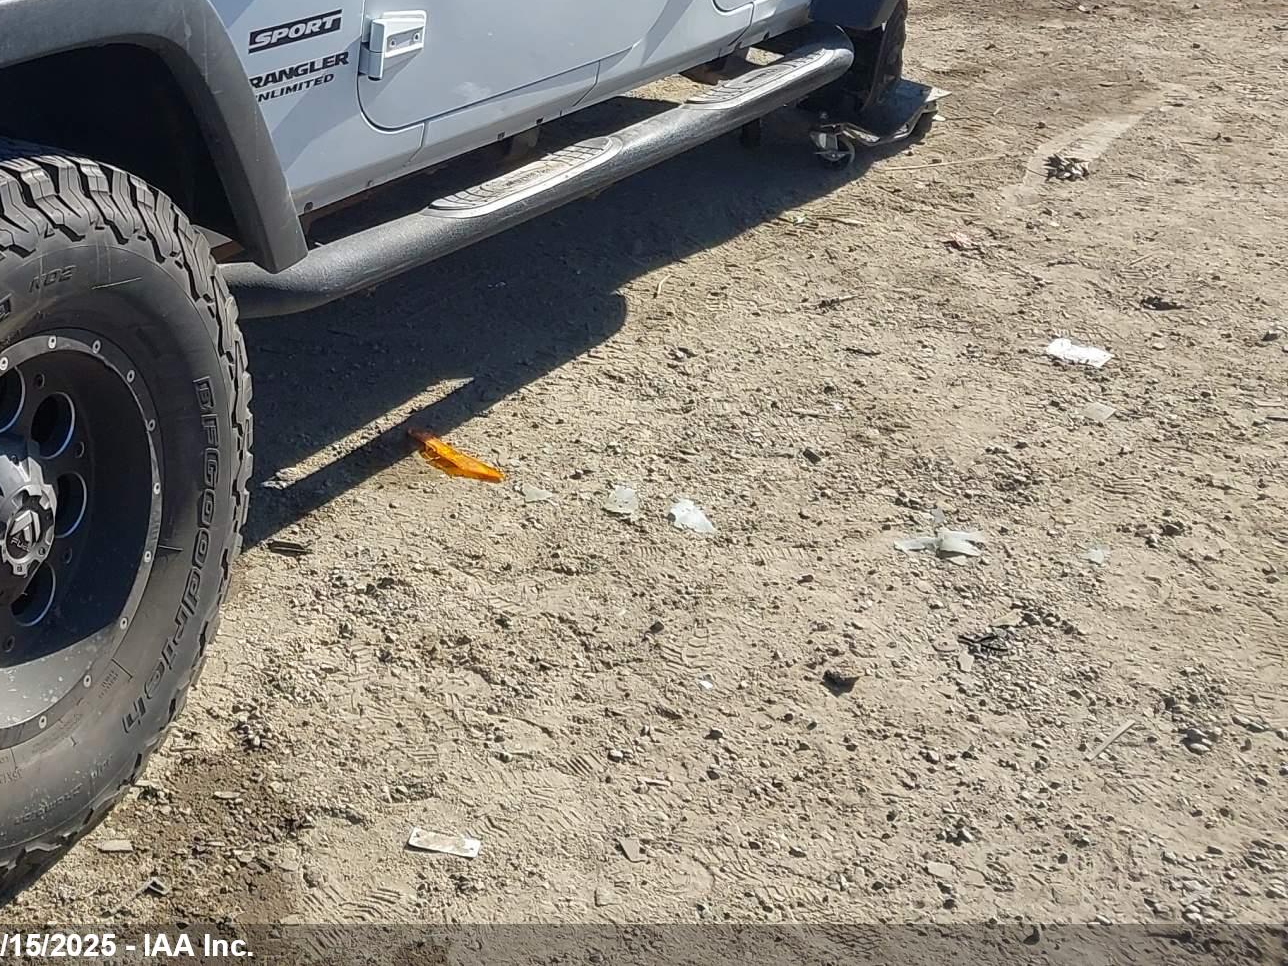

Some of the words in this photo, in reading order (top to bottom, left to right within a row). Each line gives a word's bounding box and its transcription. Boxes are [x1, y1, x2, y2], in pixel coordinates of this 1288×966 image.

[249, 13, 342, 50] SPORT
[249, 51, 349, 89] RANGLER
[255, 73, 334, 103] NLIMITED
